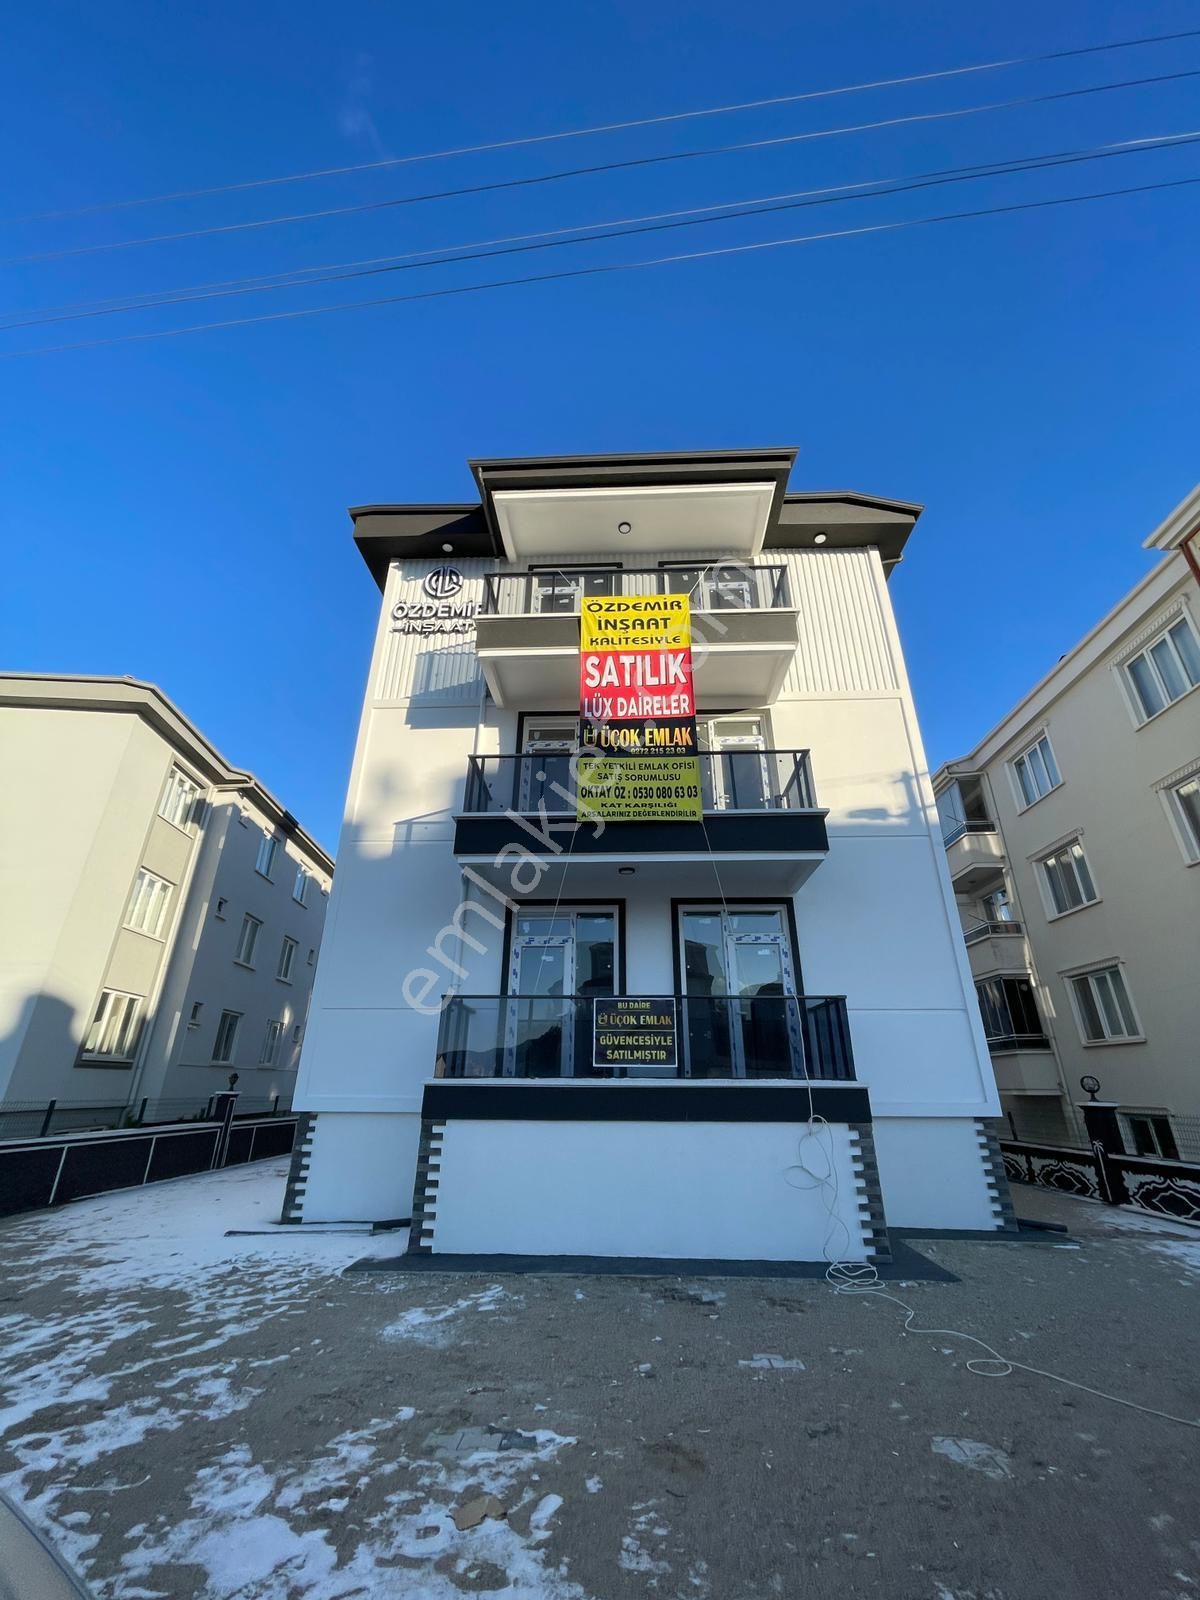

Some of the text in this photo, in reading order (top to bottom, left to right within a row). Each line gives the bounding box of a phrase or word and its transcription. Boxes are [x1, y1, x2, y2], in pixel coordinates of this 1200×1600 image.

[587, 597, 682, 613] ÖZDEMİR
[597, 616, 671, 634] İNŞAAT
[590, 635, 681, 646] KALİTESİYLE
[585, 653, 688, 688] SATILIK
[584, 693, 690, 718] LÜX DAİRELER
[600, 725, 641, 752] ÜÇOK
[645, 727, 693, 746] EMLAK
[650, 747, 664, 755] 215
[583, 761, 695, 771] TEK YETKİLİ EMLAK OFİSİ
[597, 773, 681, 783] SATIŞ SORUMLUSU
[581, 786, 612, 799] OKTAY
[614, 782, 626, 799] ÖZ
[632, 786, 654, 799] 0530
[656, 786, 672, 799] 080
[674, 786, 687, 798] 63
[687, 785, 698, 798] 03
[610, 1013, 638, 1028] ÜÇOK
[640, 1015, 673, 1025] EMLAK
[599, 1034, 673, 1046] GÜVENCESİYLE
[606, 1050, 667, 1062] SATILMIŞTIR
